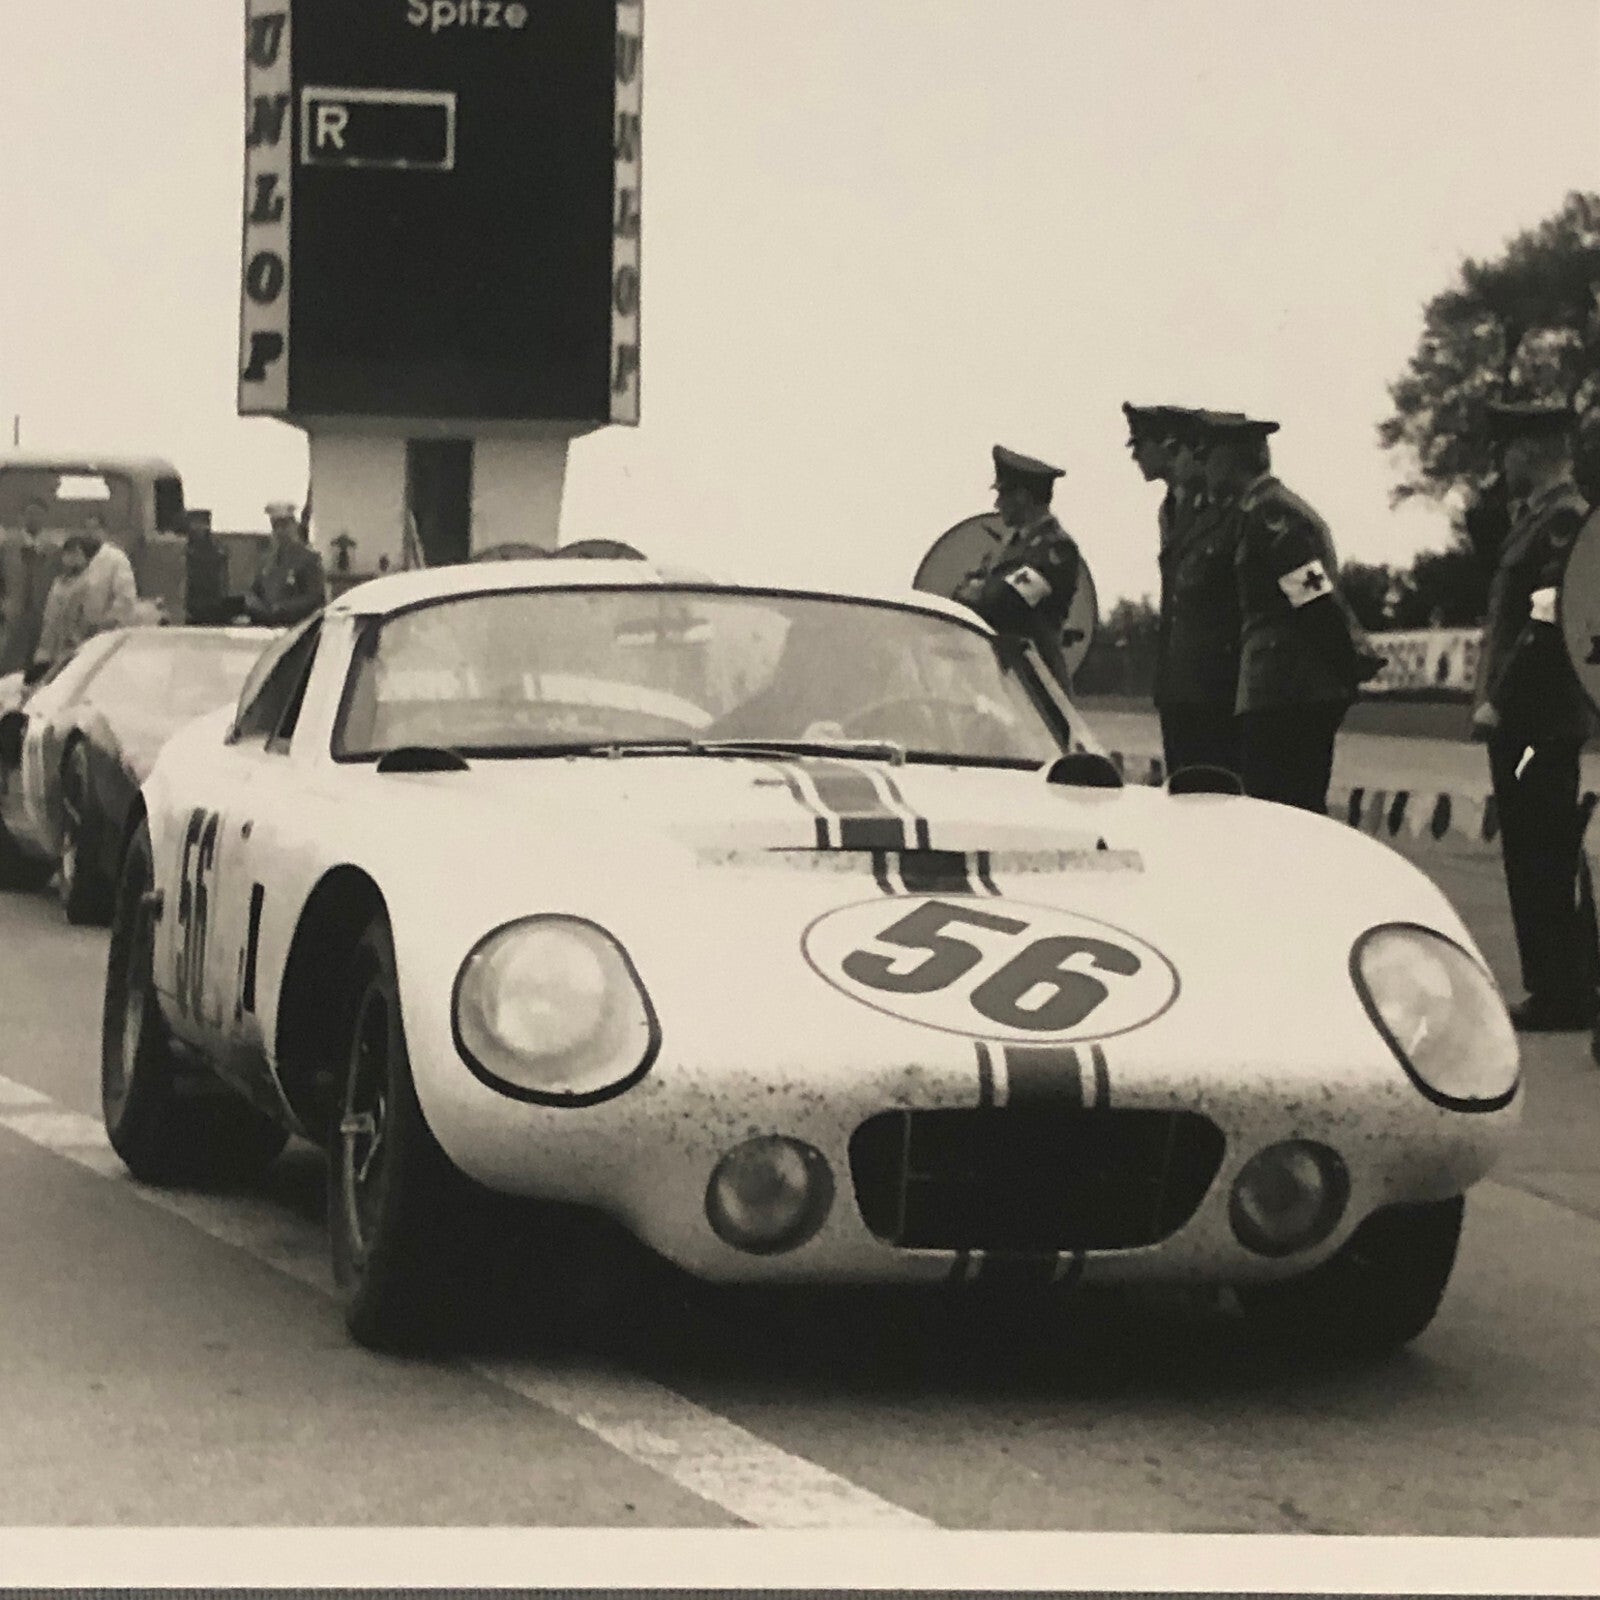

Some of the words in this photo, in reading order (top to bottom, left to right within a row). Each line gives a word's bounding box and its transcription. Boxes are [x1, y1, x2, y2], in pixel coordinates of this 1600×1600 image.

[407, 0, 528, 34] Spitze
[316, 105, 349, 150] R
[612, 0, 640, 395] UNLOP
[841, 900, 1141, 1031] 56
